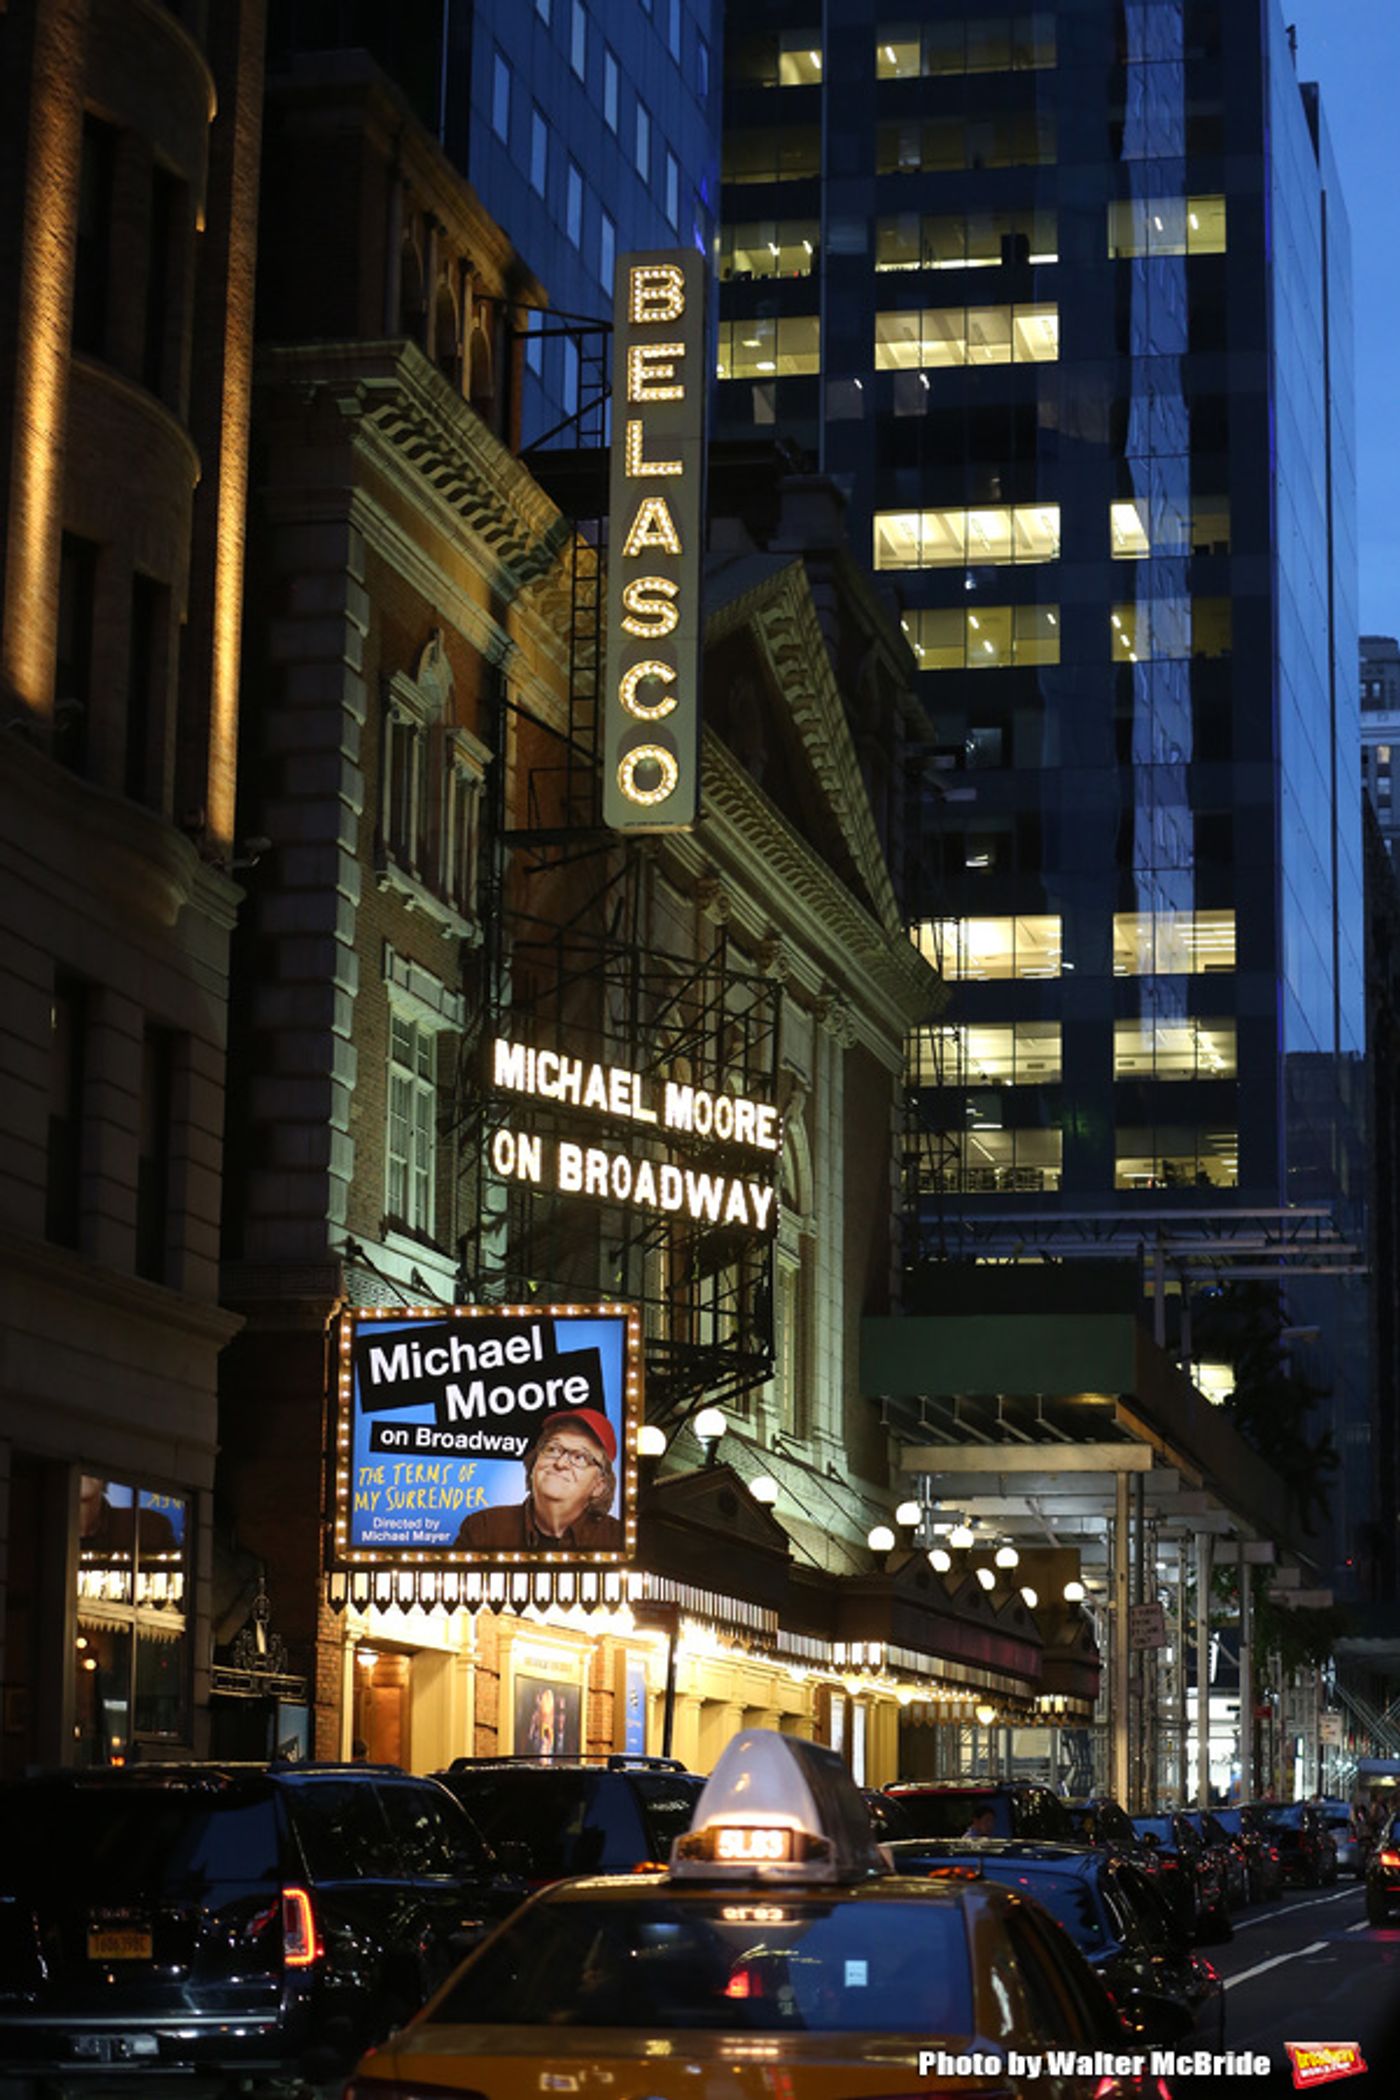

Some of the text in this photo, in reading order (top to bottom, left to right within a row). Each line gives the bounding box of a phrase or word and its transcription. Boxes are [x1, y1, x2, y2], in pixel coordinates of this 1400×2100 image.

[617, 265, 685, 806] BELASCO
[494, 1038, 777, 1150] MICHAEL MOORE
[492, 1129, 773, 1230] ON BROADWAY
[369, 1325, 543, 1384] Michael
[445, 1376, 590, 1421] Moore
[380, 1427, 529, 1456] on Broadway
[359, 1463, 478, 1487] THE TERMS OF
[354, 1486, 489, 1512] MY SURRENDER
[362, 1531, 451, 1543] Michael Mayer
[373, 1517, 440, 1531] Directed by
